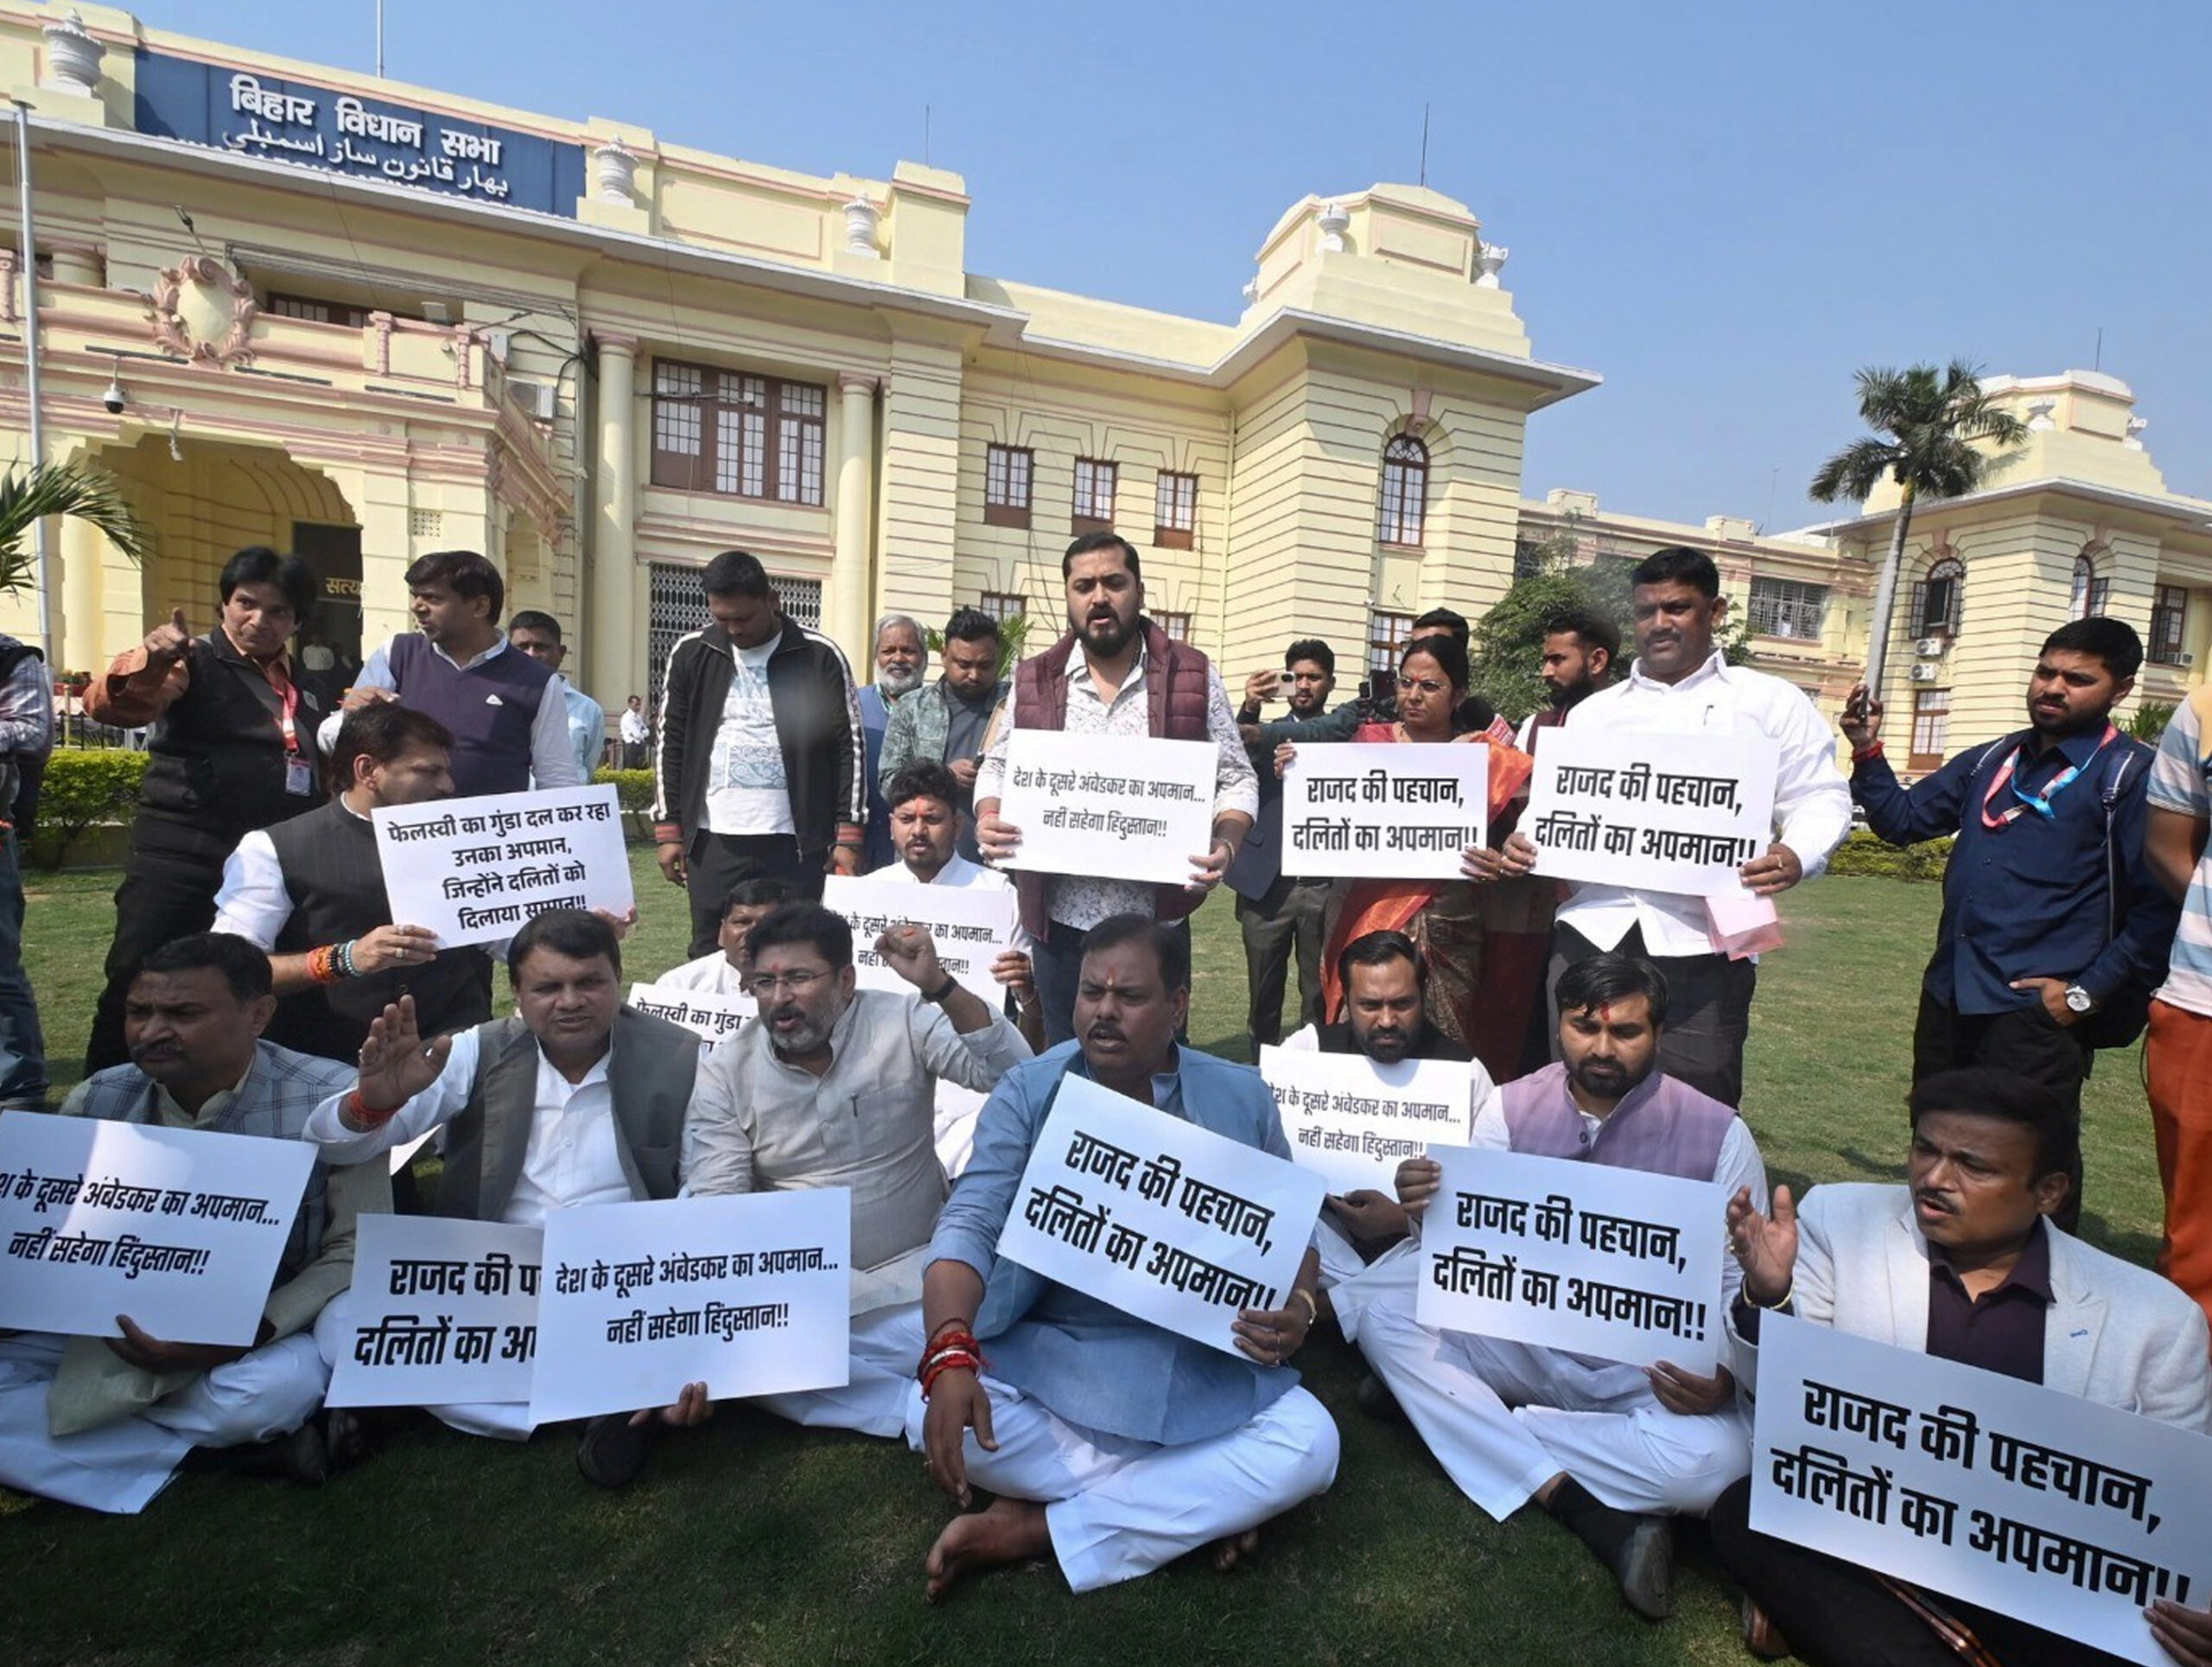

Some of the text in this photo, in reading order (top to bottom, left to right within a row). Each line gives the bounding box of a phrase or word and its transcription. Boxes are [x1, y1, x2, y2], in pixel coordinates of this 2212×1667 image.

[229, 73, 501, 165] बिहार विधान सभा
[329, 137, 377, 165] ساز
[325, 577, 361, 595] सत्य
[1014, 767, 1033, 787] देश
[1035, 767, 1046, 789] के
[1049, 770, 1077, 797] दूसरे
[1128, 779, 1145, 797] का
[1306, 769, 1464, 809] राजद की पहचान,
[1556, 762, 1743, 818] राजद की पहचान,
[388, 802, 610, 843] फेलस्वी का गुंडा दल कर रहा
[1043, 806, 1068, 828] नहीं
[1070, 808, 1105, 831] सहेगा
[1292, 818, 1351, 850] दलितों
[1355, 825, 1381, 850] का
[1535, 811, 1757, 868] दलितों का अपमान!!
[453, 837, 572, 866] उनका अपमान,
[442, 861, 586, 900] जिन्होंने दलितों को
[458, 904, 520, 930] दिलाया
[935, 923, 949, 939] का
[691, 1009, 712, 1026] का
[715, 1008, 742, 1034] गुंडा
[1288, 1085, 1300, 1105] के
[1302, 1090, 1330, 1116] दूसरे
[1382, 1099, 1398, 1117] का
[1299, 1125, 1324, 1148] नहीं
[1324, 1129, 1359, 1152] सहेगा
[15, 1169, 38, 1200] के
[35, 1174, 84, 1212] दूसरे
[83, 1176, 162, 1213] अंबेडकर
[162, 1190, 191, 1217] का
[1064, 1130, 1276, 1257] राजद की पहचान,
[1024, 1184, 1112, 1254] दलितों
[1104, 1223, 1147, 1270] का
[1456, 1192, 1687, 1275] राजद की पहचान,
[9, 1226, 210, 1280] नहीं सहेगा हिंदुस्तान!!
[390, 1260, 469, 1295] राजद
[474, 1252, 513, 1296] की
[556, 1263, 588, 1295] देश
[591, 1260, 610, 1291] के
[613, 1255, 655, 1298] दूसरे
[659, 1252, 728, 1283] अंबेडकर
[732, 1252, 754, 1276] का
[1433, 1245, 1707, 1341] दलितों का अपमान!!
[354, 1314, 453, 1366] दलितों
[454, 1327, 497, 1364] का
[607, 1301, 789, 1345] नहीं सहेगा हिंदुस्तान!!
[1802, 1378, 2162, 1535] राजद की पहचान,
[1770, 1444, 1893, 1525] दलितों
[1899, 1487, 1959, 1546] का
